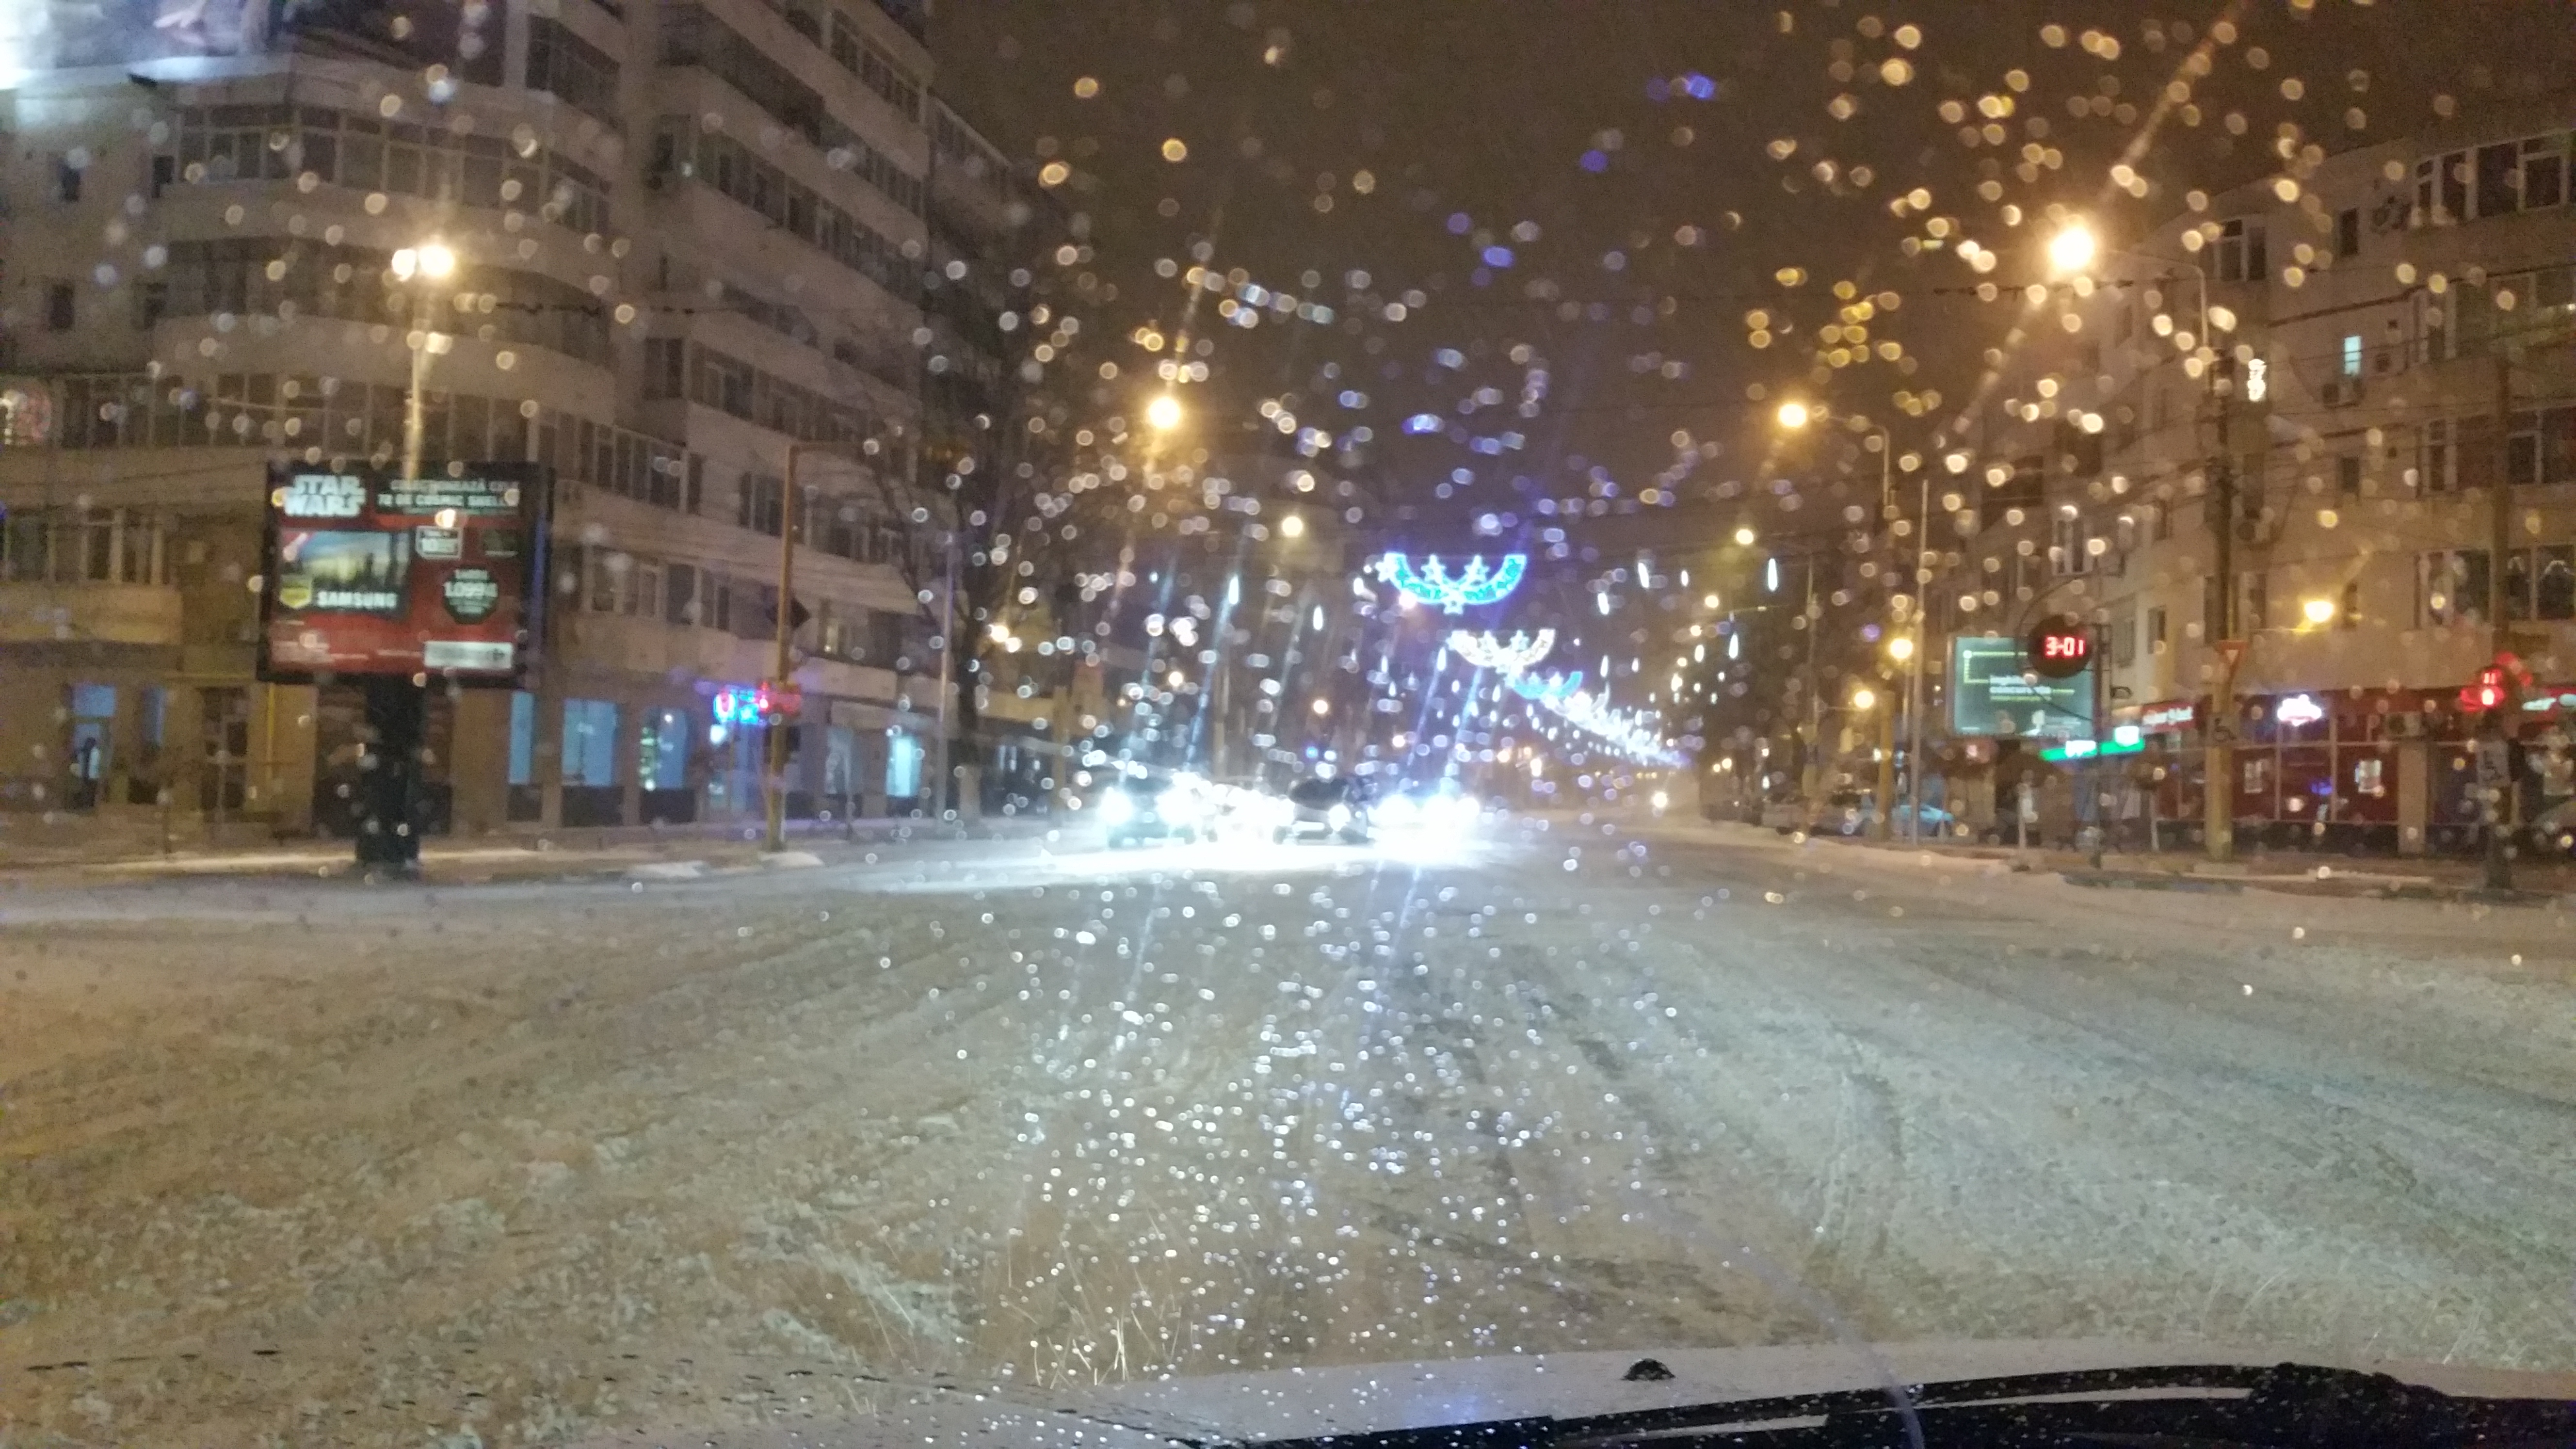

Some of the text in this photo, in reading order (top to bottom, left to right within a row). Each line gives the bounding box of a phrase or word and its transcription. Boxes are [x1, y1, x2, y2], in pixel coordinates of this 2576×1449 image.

[293, 475, 365, 495] STAR
[284, 495, 365, 516] WARS
[317, 591, 397, 609] SAMSUNG
